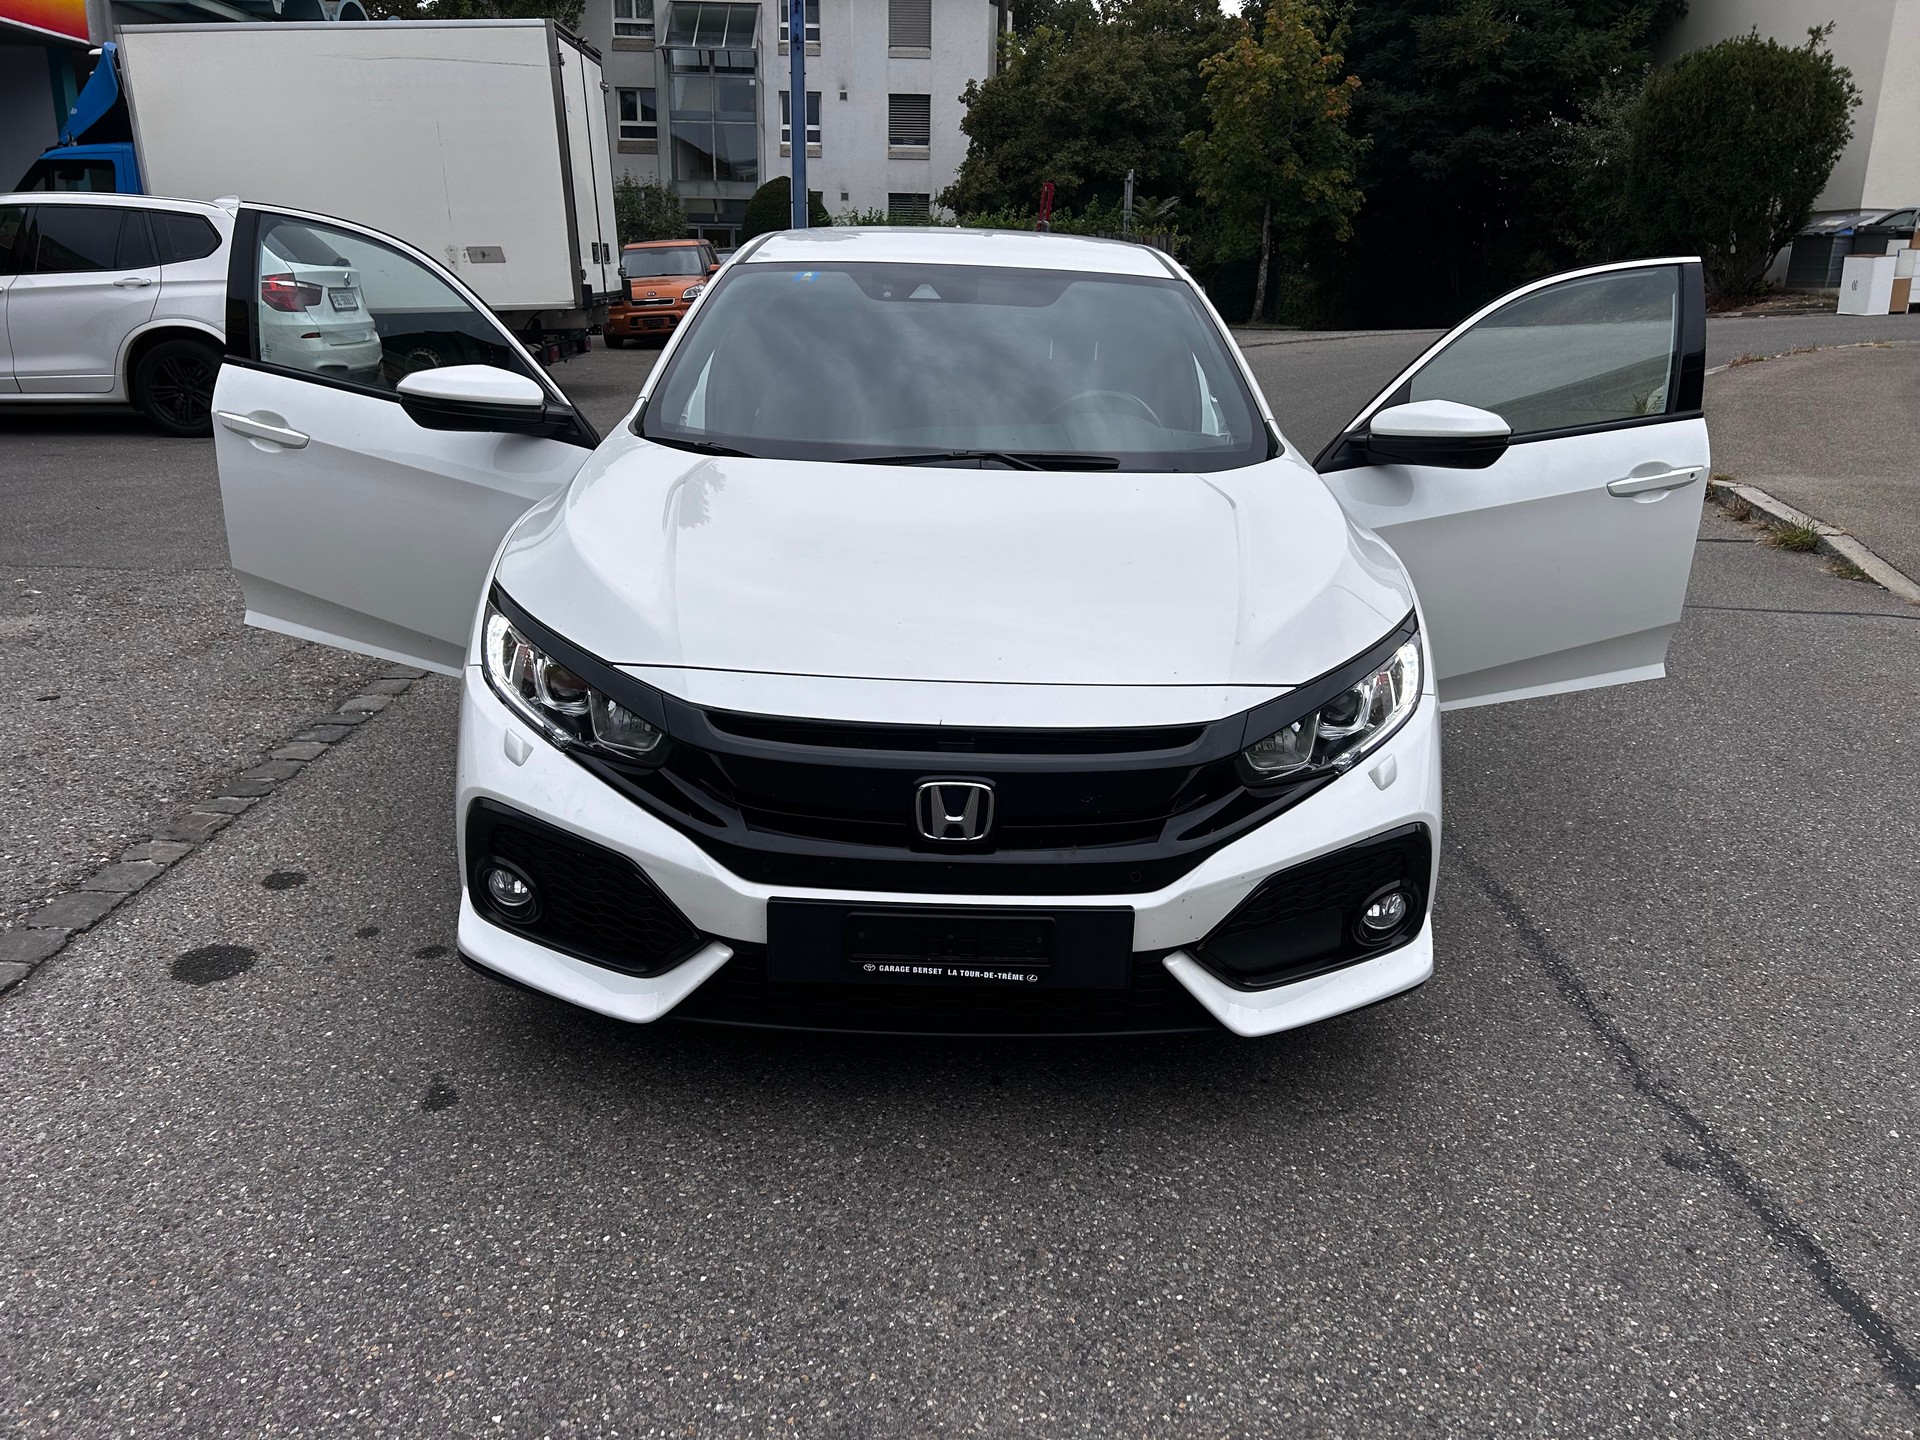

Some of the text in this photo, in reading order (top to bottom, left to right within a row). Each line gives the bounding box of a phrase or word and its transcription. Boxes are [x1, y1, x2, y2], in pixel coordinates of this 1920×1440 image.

[879, 964, 1024, 981] GARAGE BERSET LA TOUR-DE-TRÊME
